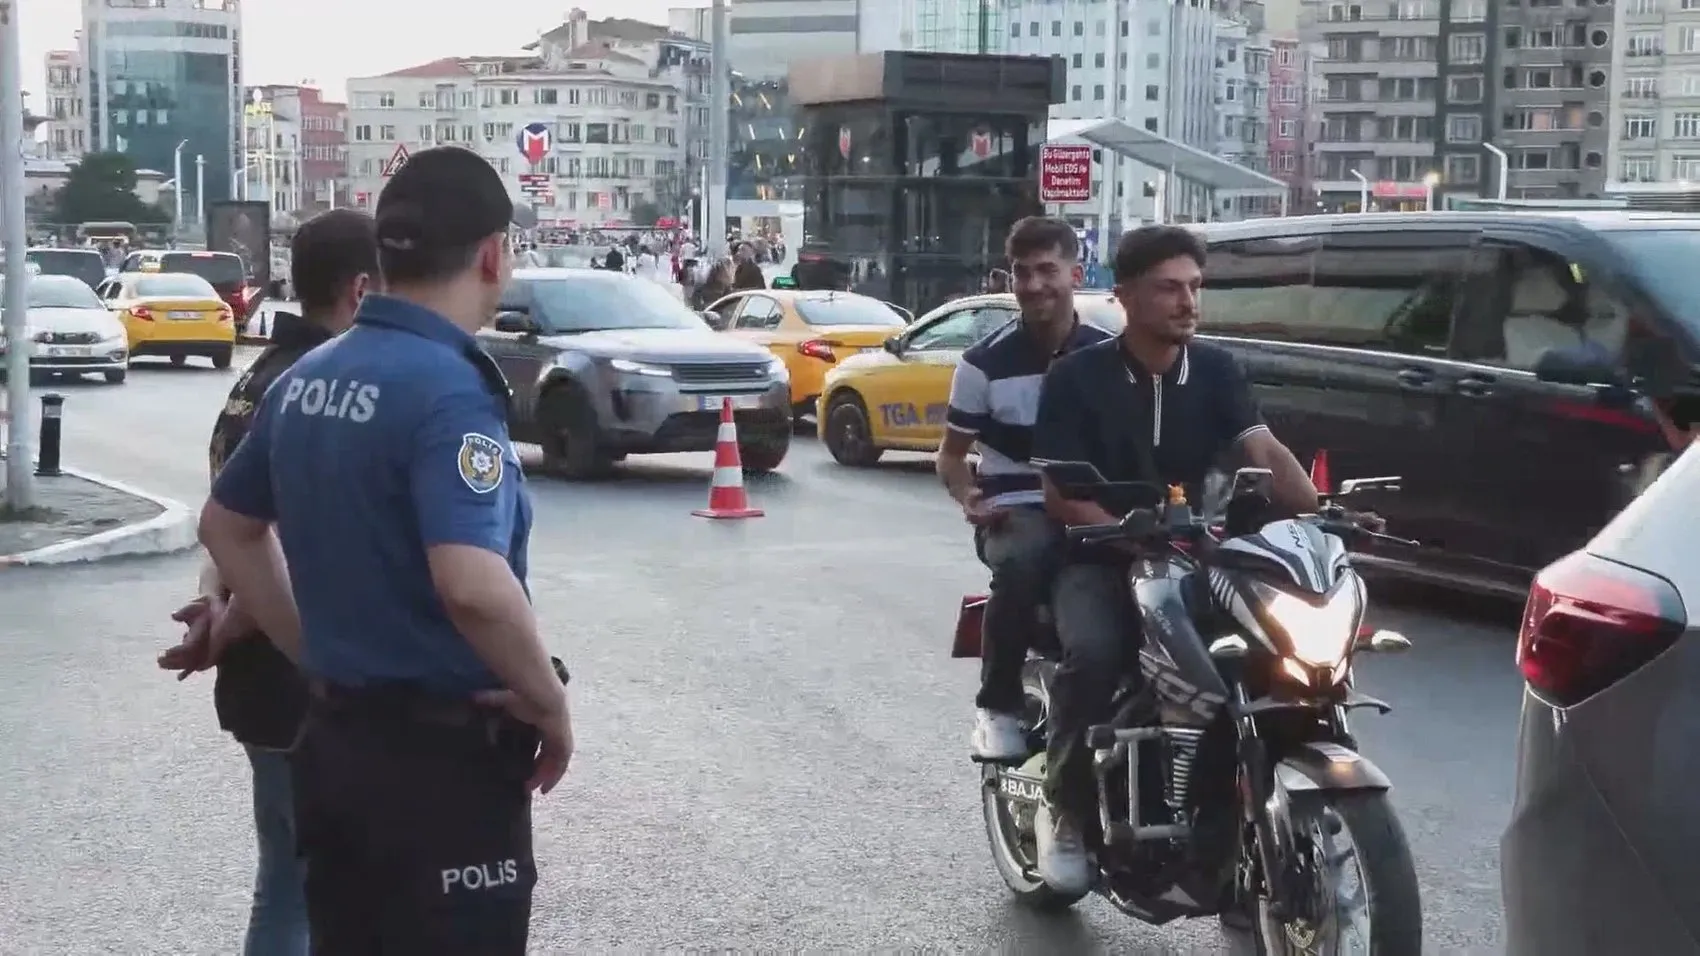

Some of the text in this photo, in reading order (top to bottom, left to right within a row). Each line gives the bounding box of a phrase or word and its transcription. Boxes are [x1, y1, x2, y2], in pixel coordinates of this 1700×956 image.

[523, 128, 549, 151] M
[1043, 148, 1053, 159] Bu
[1044, 163, 1064, 174] Mobil
[1064, 163, 1079, 174] EDS
[1051, 175, 1082, 186] Denetim
[1008, 778, 1045, 801] BAJA
